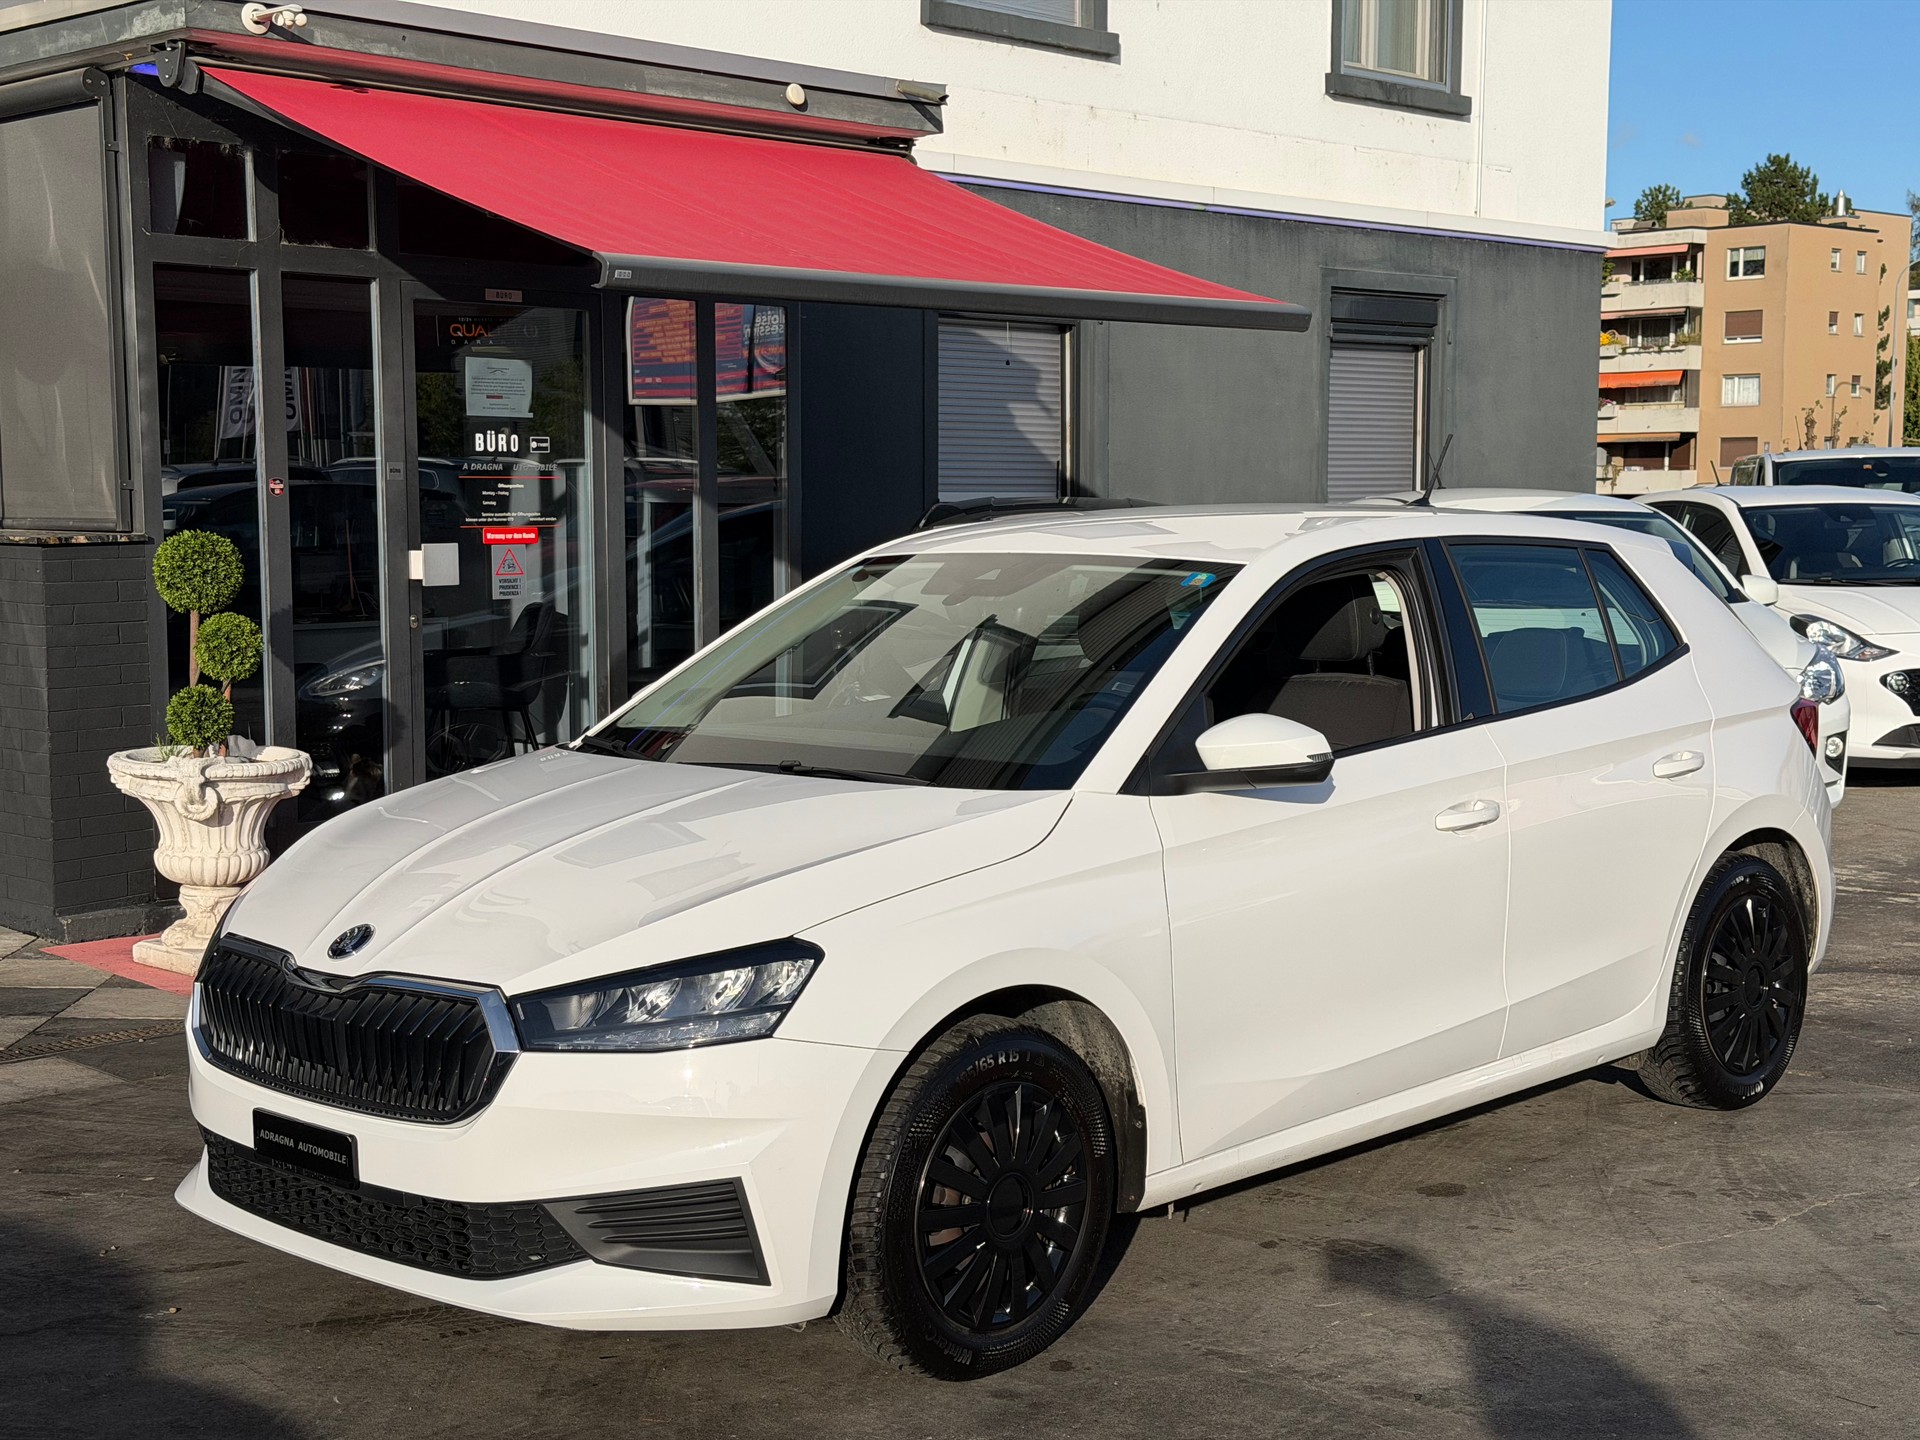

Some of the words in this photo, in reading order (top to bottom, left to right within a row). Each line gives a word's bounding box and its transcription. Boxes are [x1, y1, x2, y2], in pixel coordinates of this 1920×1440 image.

[475, 430, 519, 452] BÜRO
[260, 1128, 295, 1149] ADRAGNA
[297, 1141, 347, 1165] AUTOMOBILE
